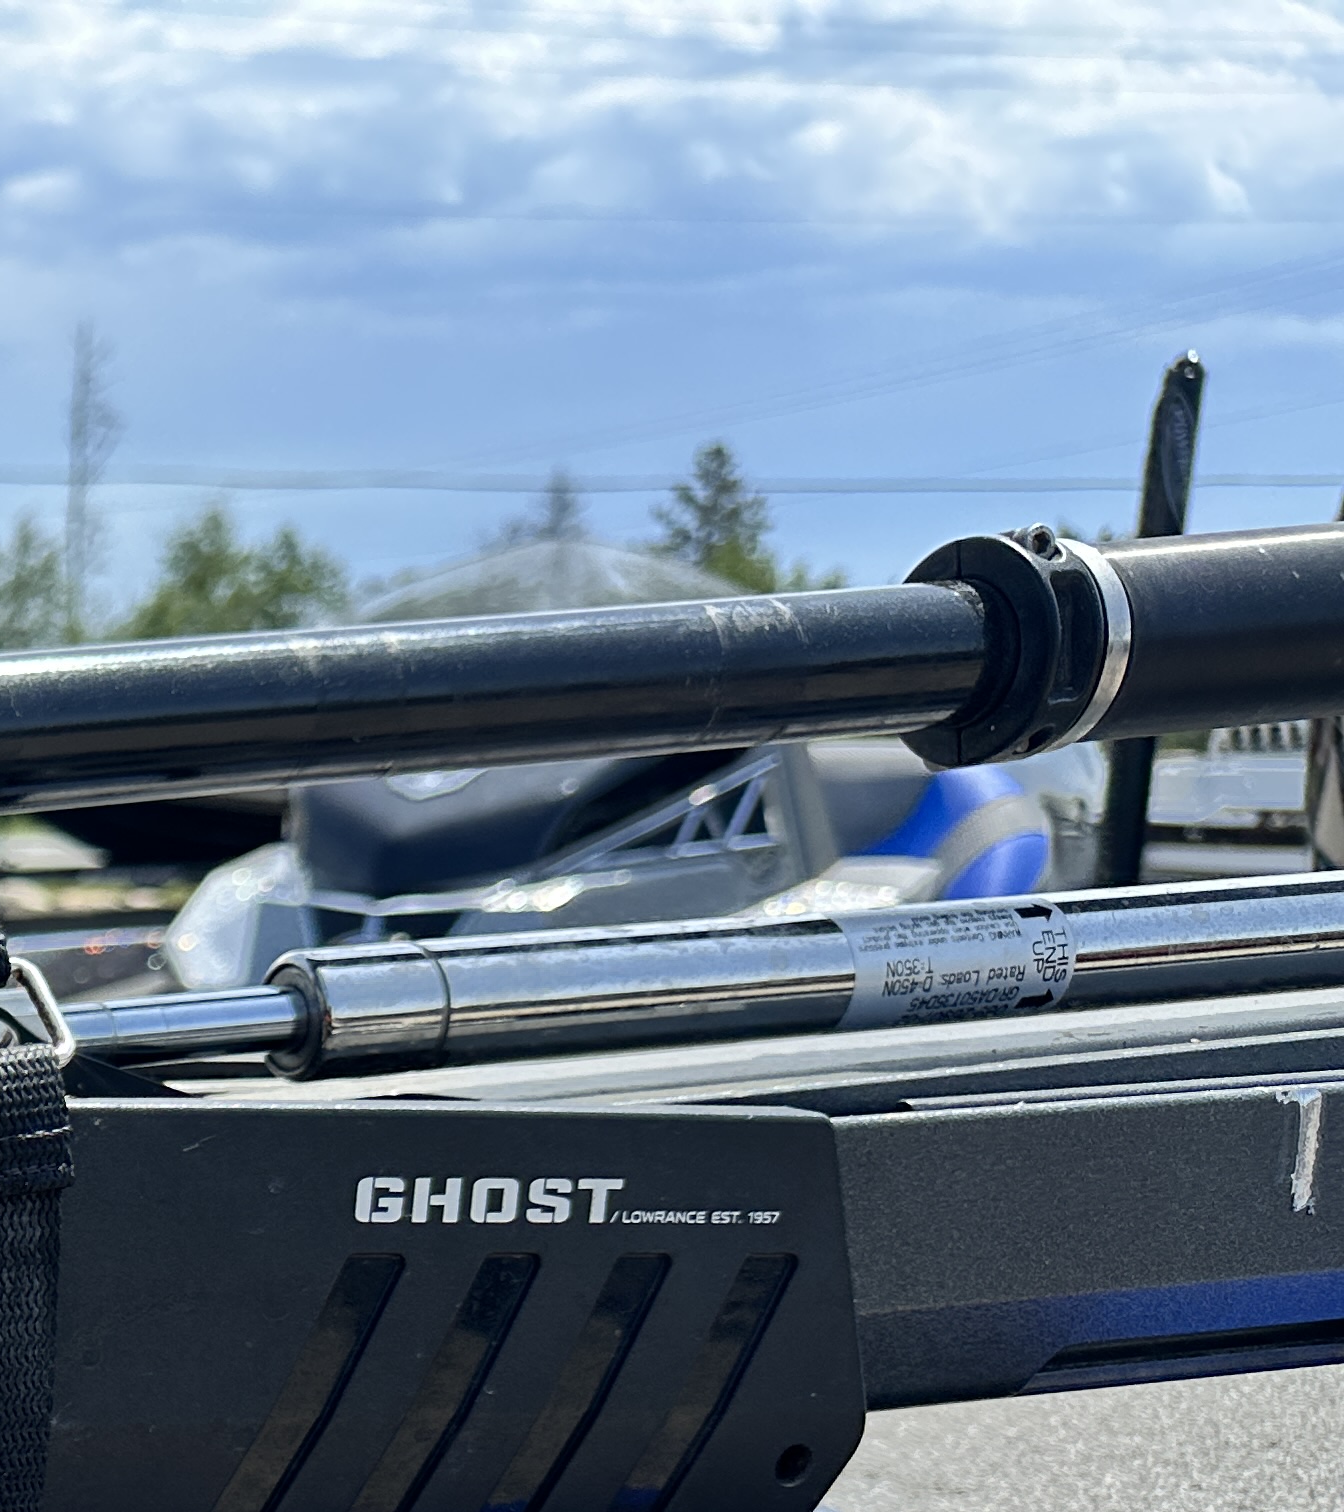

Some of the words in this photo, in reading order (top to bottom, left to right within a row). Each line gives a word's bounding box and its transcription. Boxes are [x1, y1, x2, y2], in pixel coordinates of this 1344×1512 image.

[1032, 941, 1045, 974] UP
[1041, 930, 1056, 982] END
[1054, 926, 1069, 983] THIS
[986, 964, 1026, 986] Rated
[354, 1176, 626, 1224] GHOST
[621, 1210, 707, 1224] LOWRANCE
[710, 1210, 742, 1224] EST.
[746, 1210, 782, 1224] 1957
